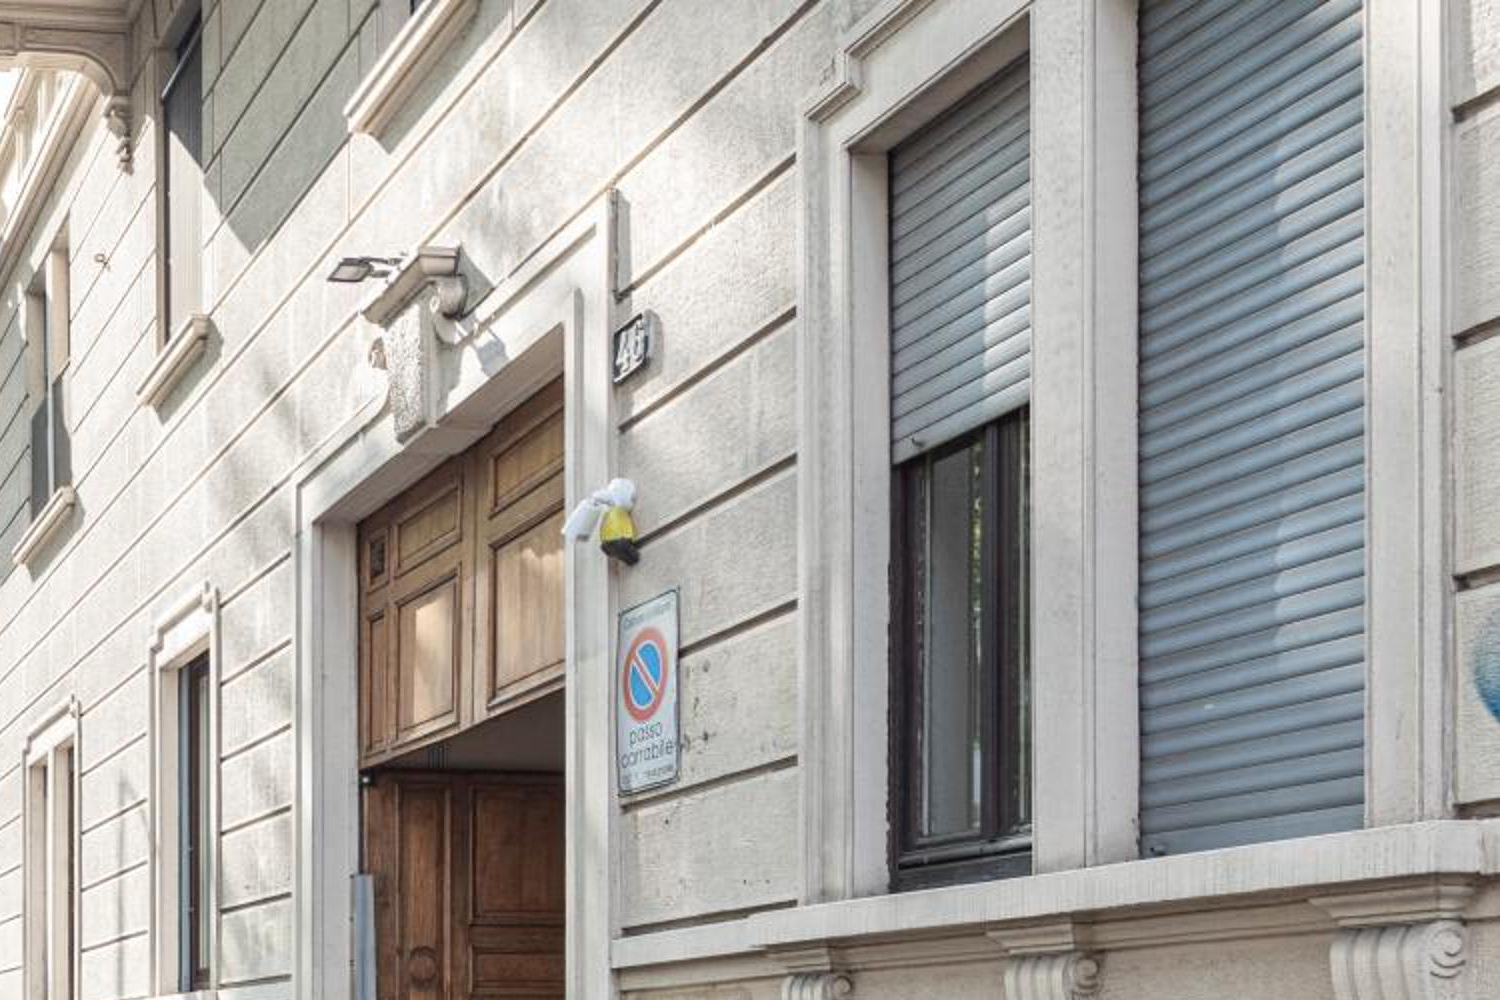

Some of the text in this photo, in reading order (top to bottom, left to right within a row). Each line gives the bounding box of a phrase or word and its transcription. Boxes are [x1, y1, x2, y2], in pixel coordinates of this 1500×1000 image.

[615, 319, 645, 370] 46
[629, 721, 663, 747] passo
[621, 739, 675, 769] carrabile
